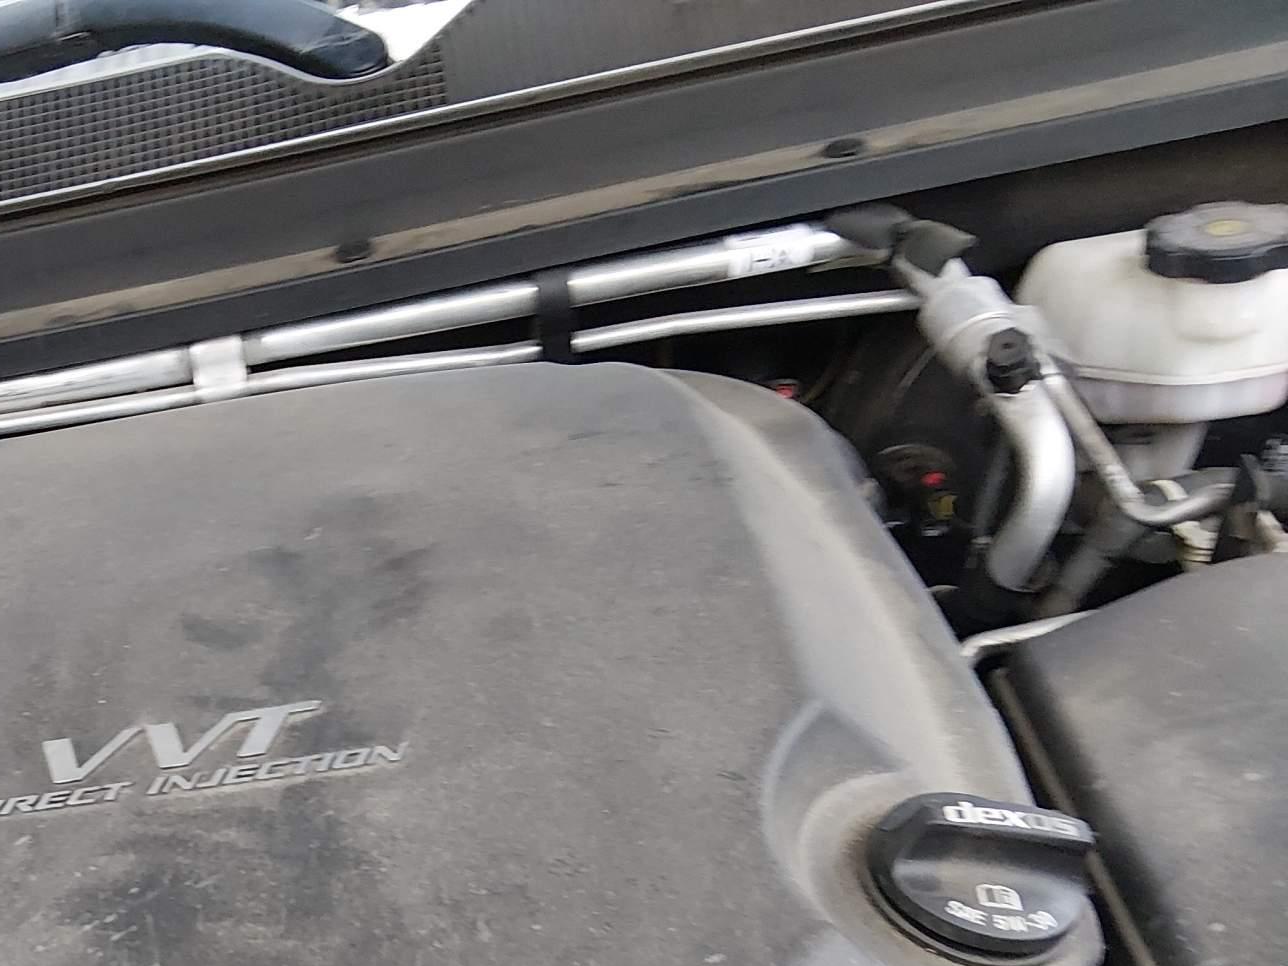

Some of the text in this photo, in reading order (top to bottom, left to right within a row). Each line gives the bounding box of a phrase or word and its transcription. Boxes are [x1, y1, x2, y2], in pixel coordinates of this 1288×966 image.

[42, 700, 323, 784] VVT
[145, 742, 410, 796] INJECTION
[942, 801, 1080, 837] dexos
